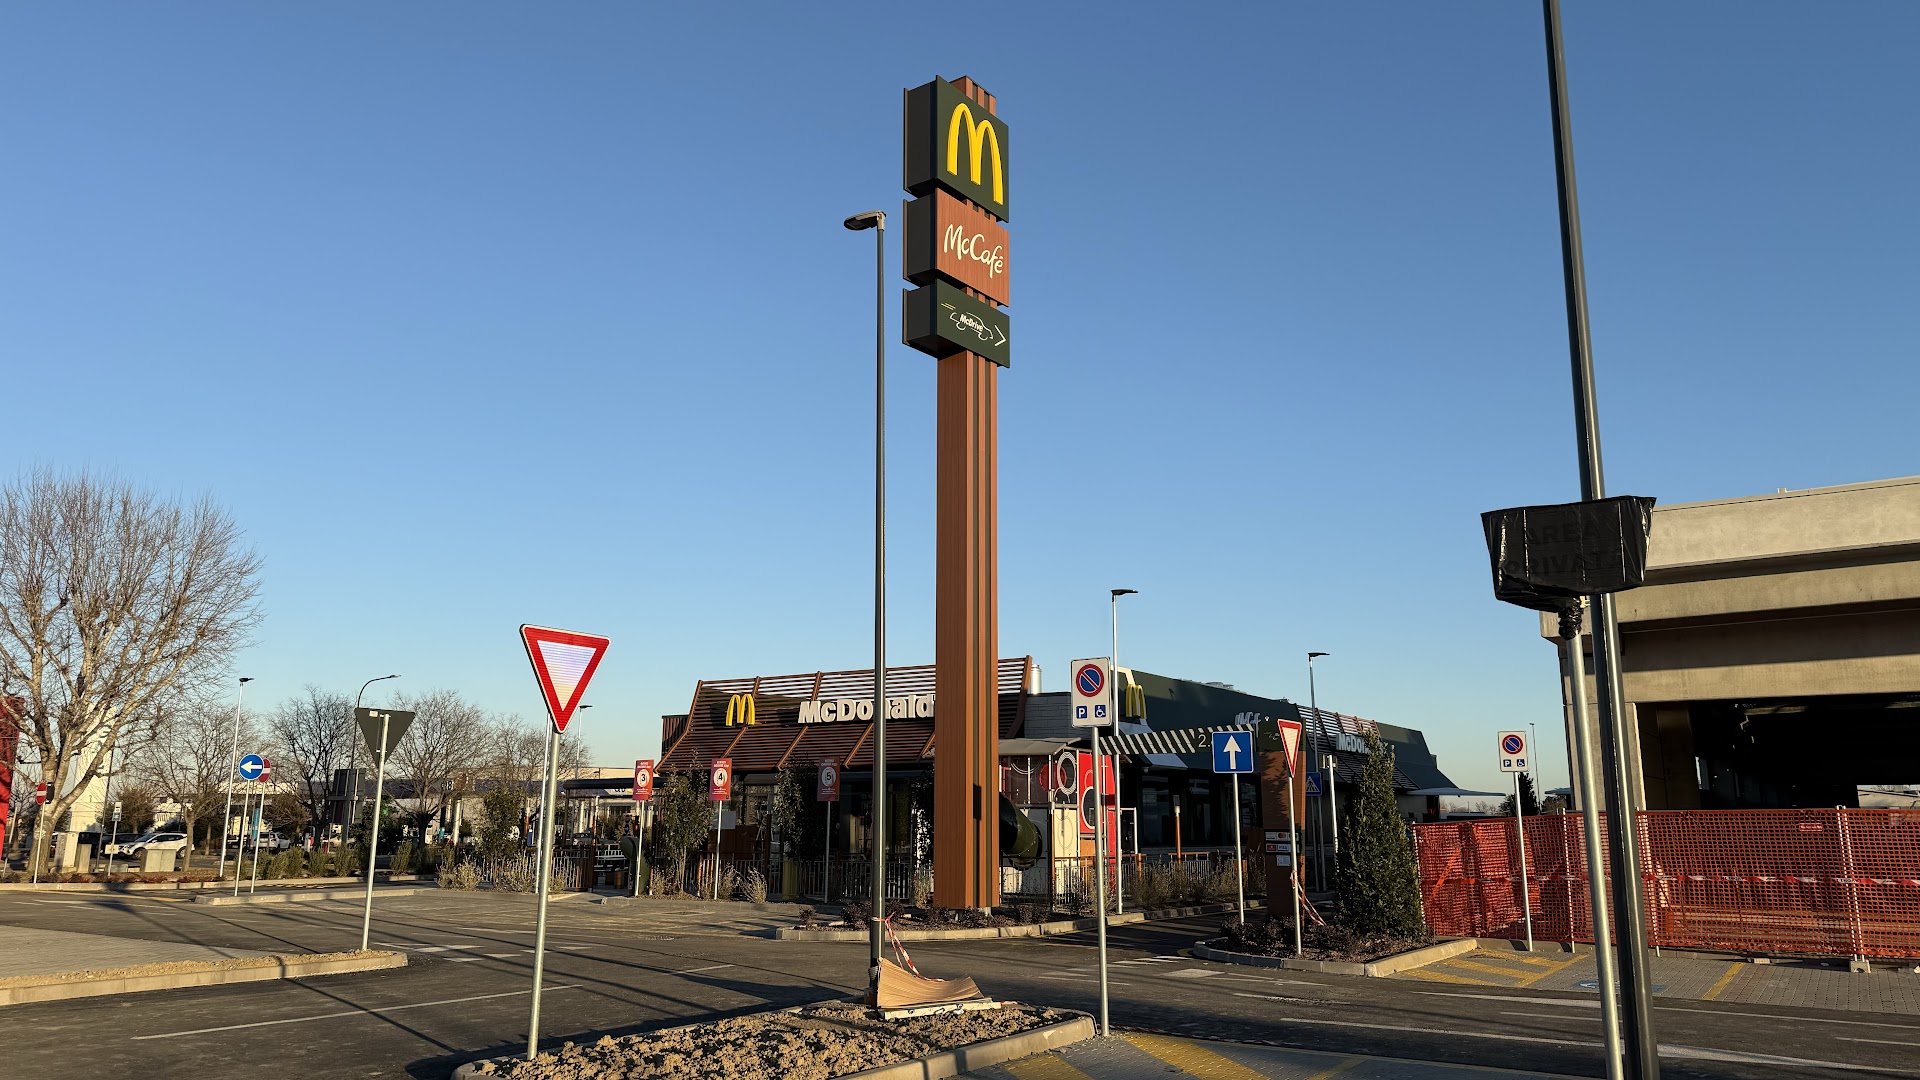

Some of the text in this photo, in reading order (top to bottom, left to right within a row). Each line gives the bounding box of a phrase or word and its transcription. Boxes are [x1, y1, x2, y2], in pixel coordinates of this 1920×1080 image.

[943, 223, 1004, 279] McCafé
[959, 313, 984, 332] McDrive
[1078, 707, 1086, 718] P
